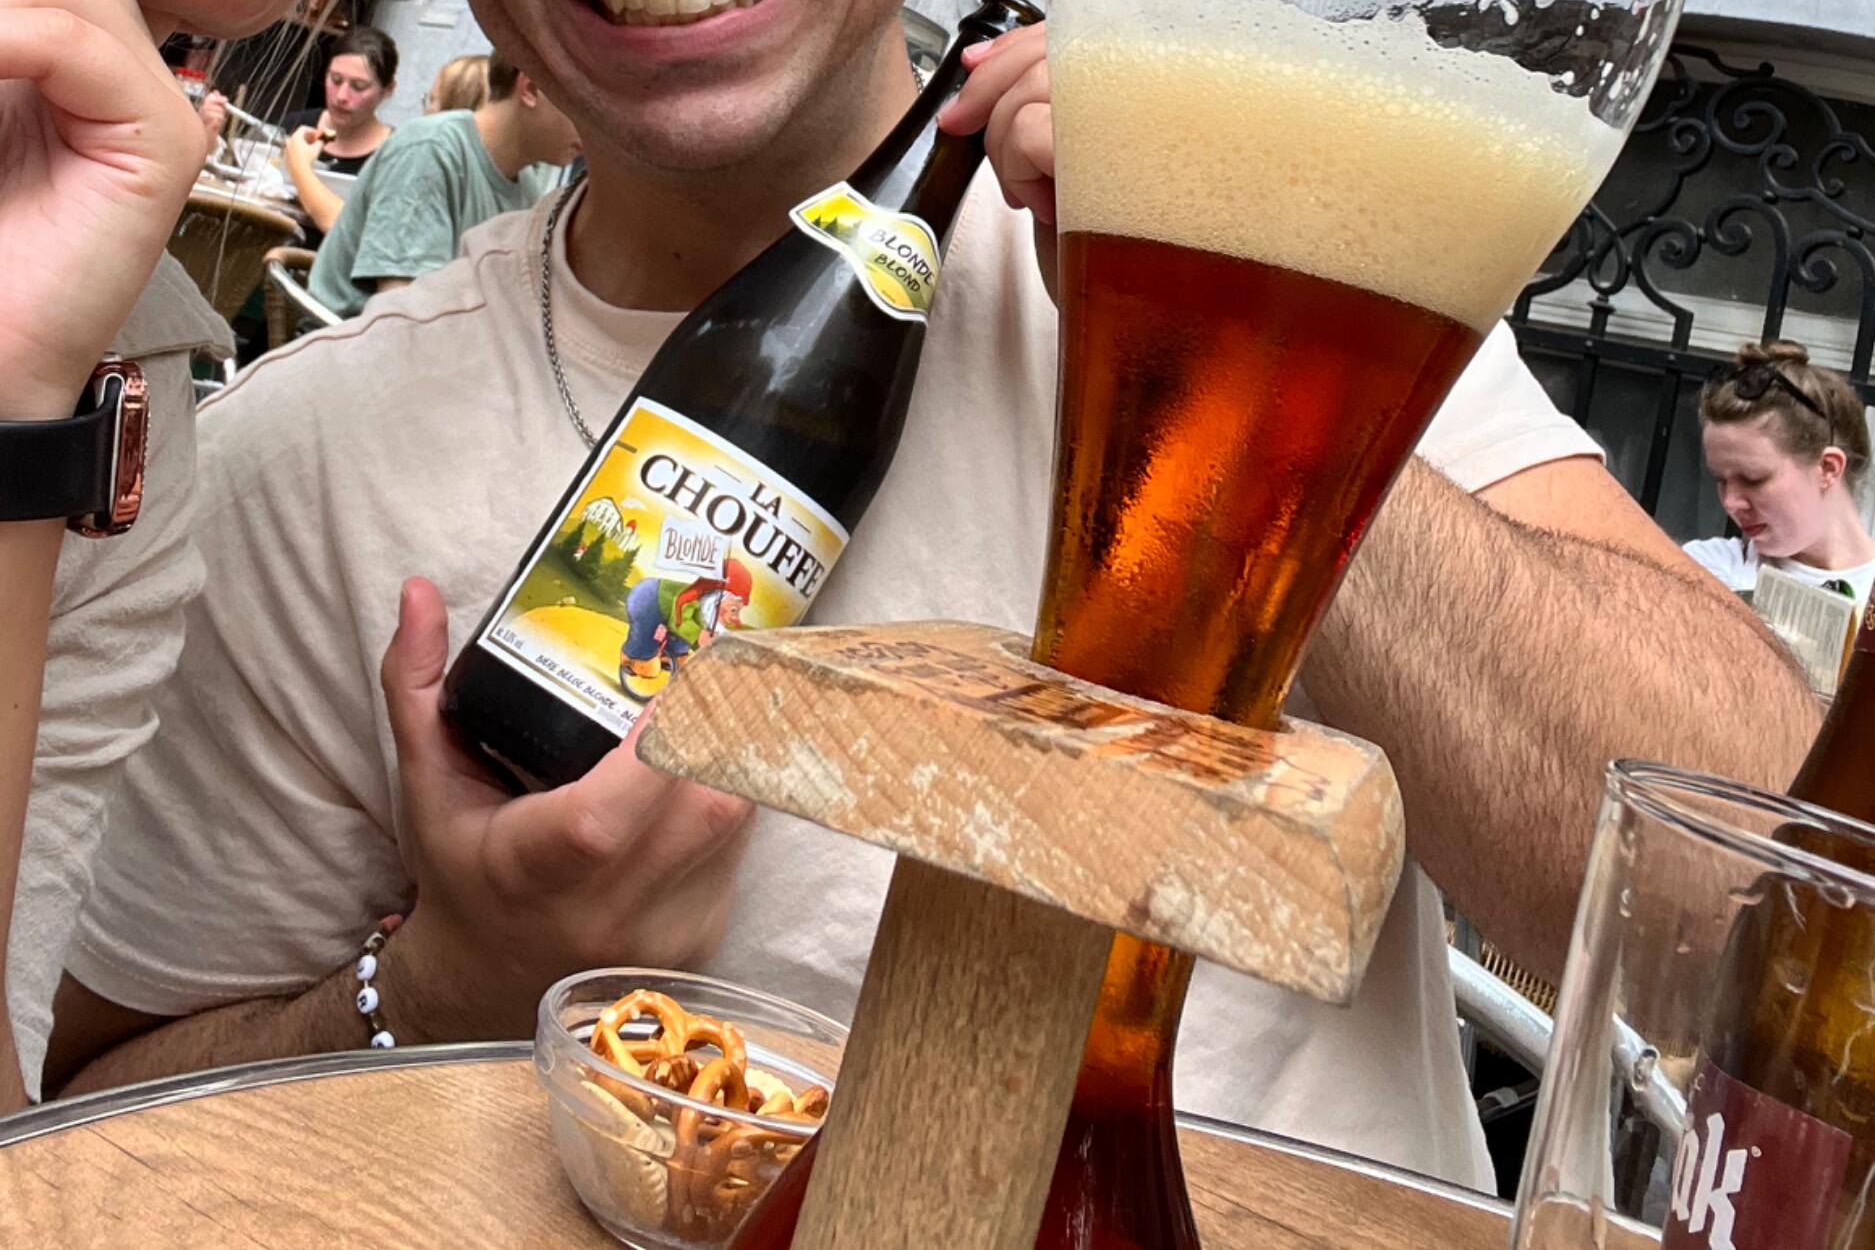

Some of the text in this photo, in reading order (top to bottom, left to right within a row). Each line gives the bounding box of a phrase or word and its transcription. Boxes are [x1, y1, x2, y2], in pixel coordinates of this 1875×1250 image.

[869, 229, 935, 286] BLONDE
[874, 253, 921, 292] BLOND
[749, 481, 784, 519] LA
[640, 454, 826, 599] CHOUFFE
